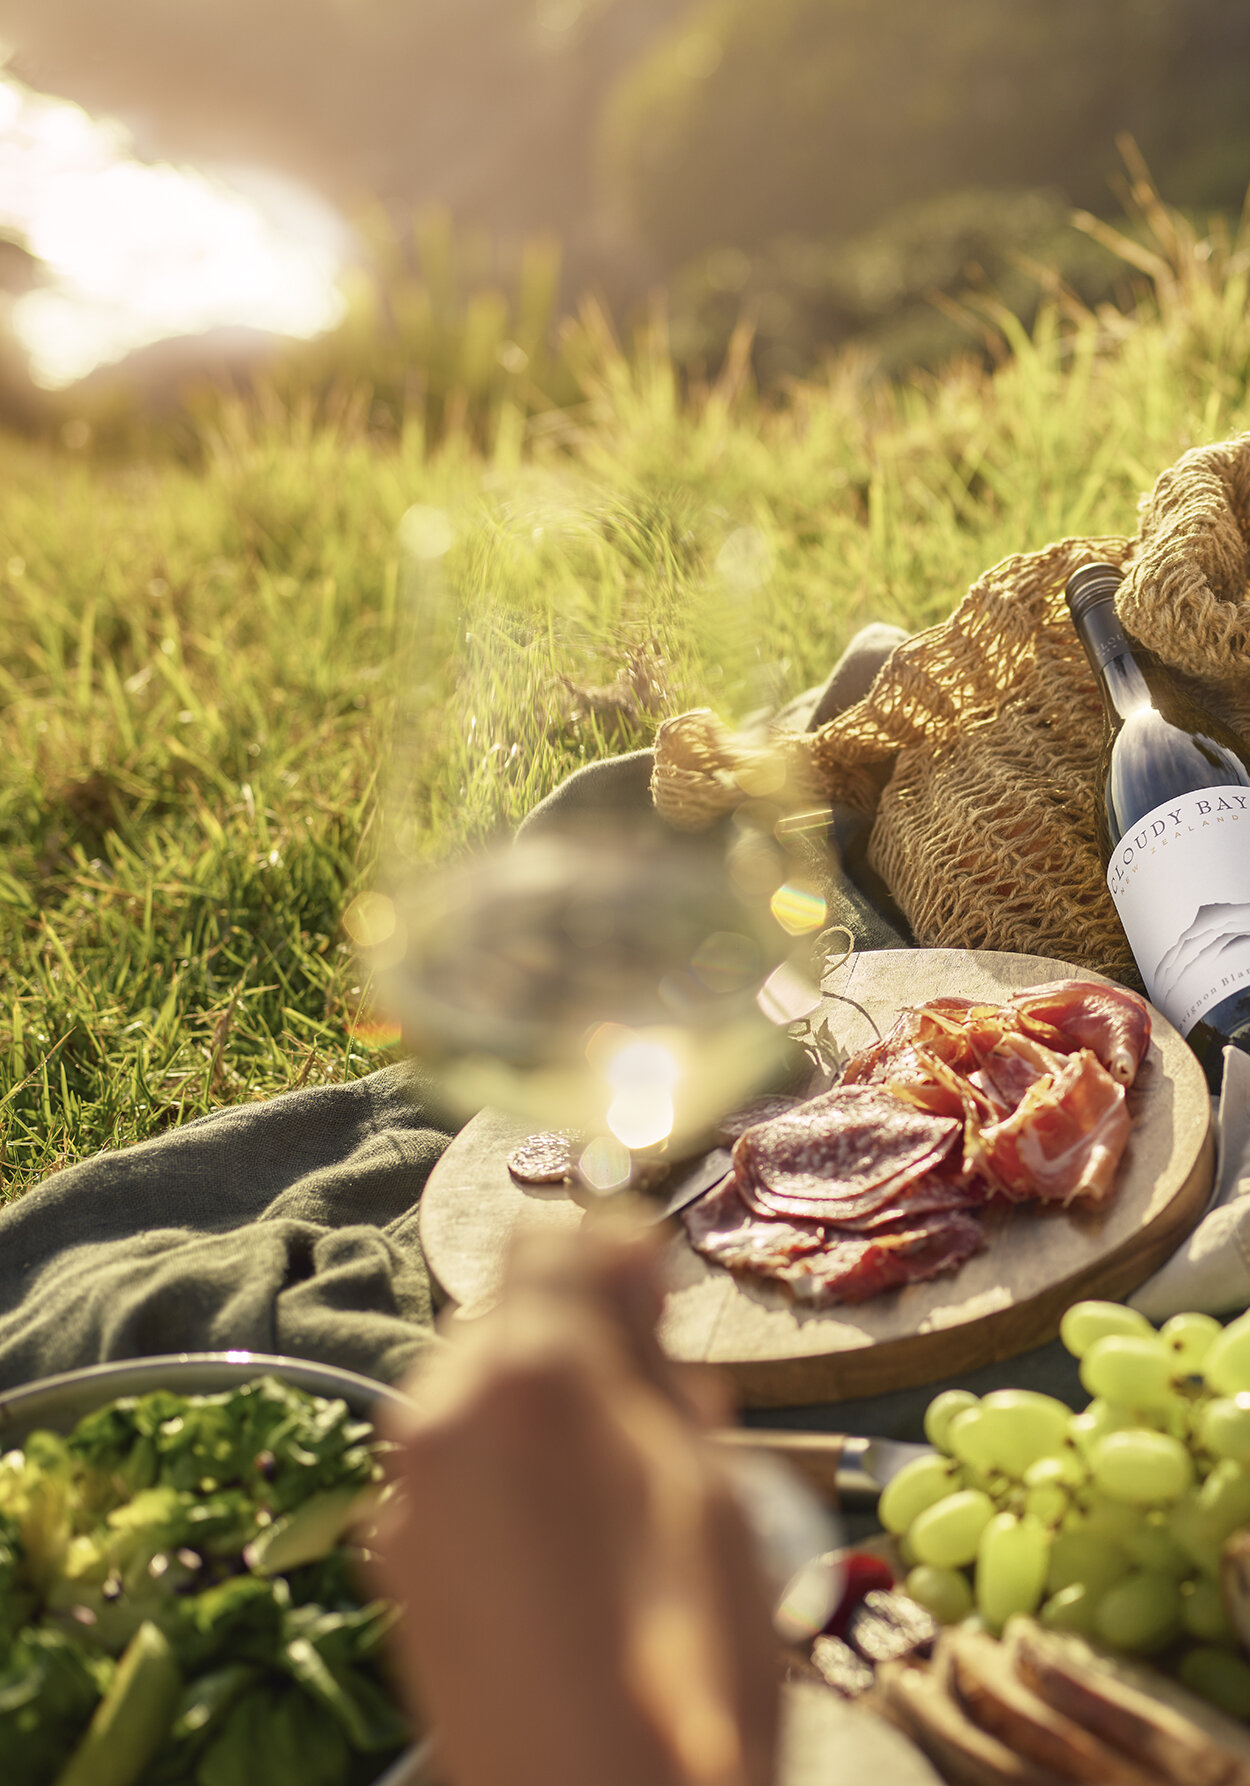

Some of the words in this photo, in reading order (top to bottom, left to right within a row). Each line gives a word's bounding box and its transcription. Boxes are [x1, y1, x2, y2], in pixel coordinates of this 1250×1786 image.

[1110, 808, 1183, 895] CLOUDY
[1195, 796, 1248, 815] BAY
[1151, 814, 1239, 855] ZEALAND
